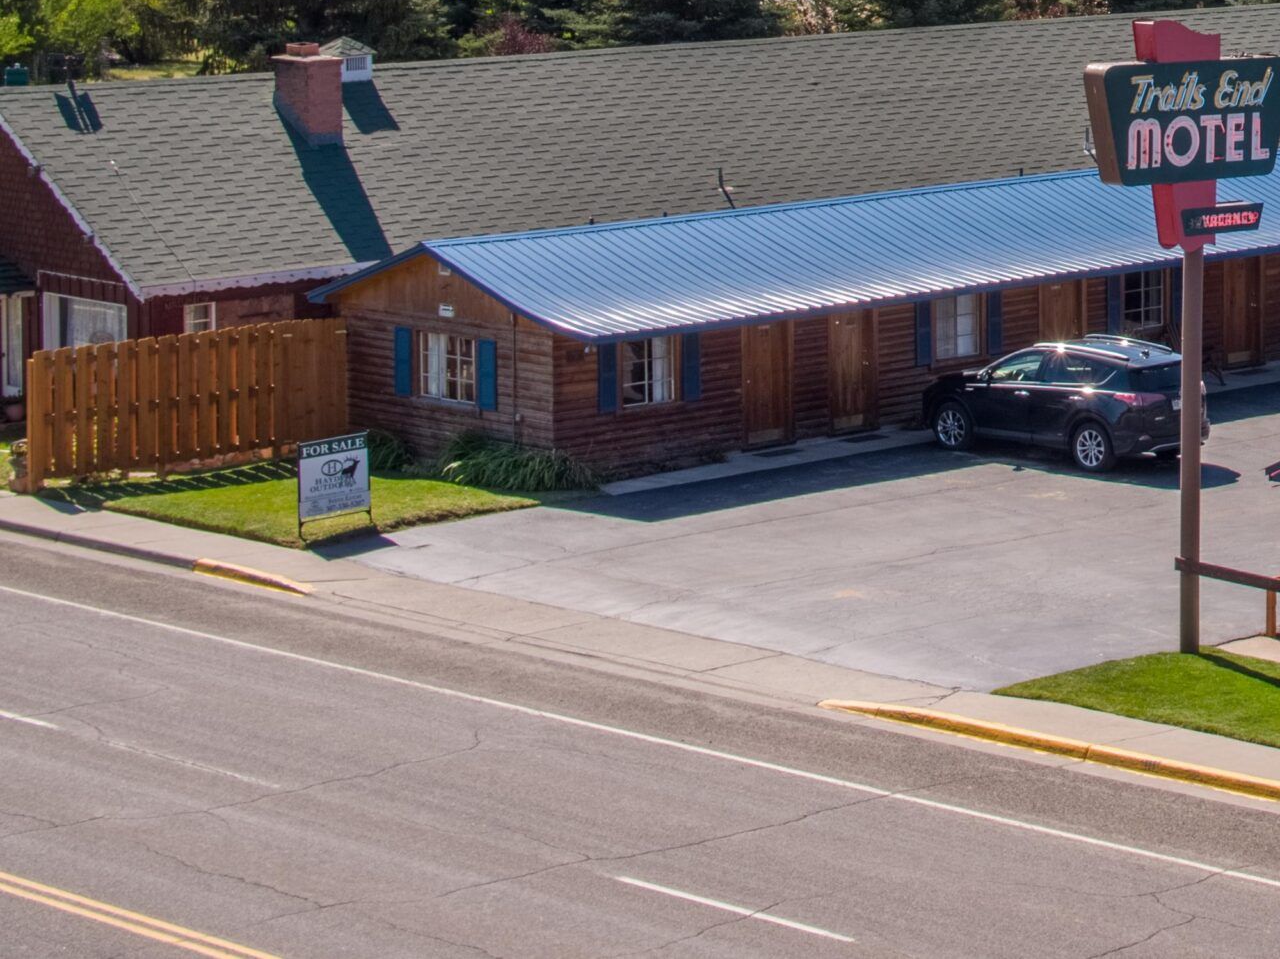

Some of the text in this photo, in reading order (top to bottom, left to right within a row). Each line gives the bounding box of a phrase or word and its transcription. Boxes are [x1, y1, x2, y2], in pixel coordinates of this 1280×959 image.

[1130, 66, 1273, 114] Trails End
[1127, 112, 1270, 170] MOTEL
[302, 437, 365, 457] FOR SALE
